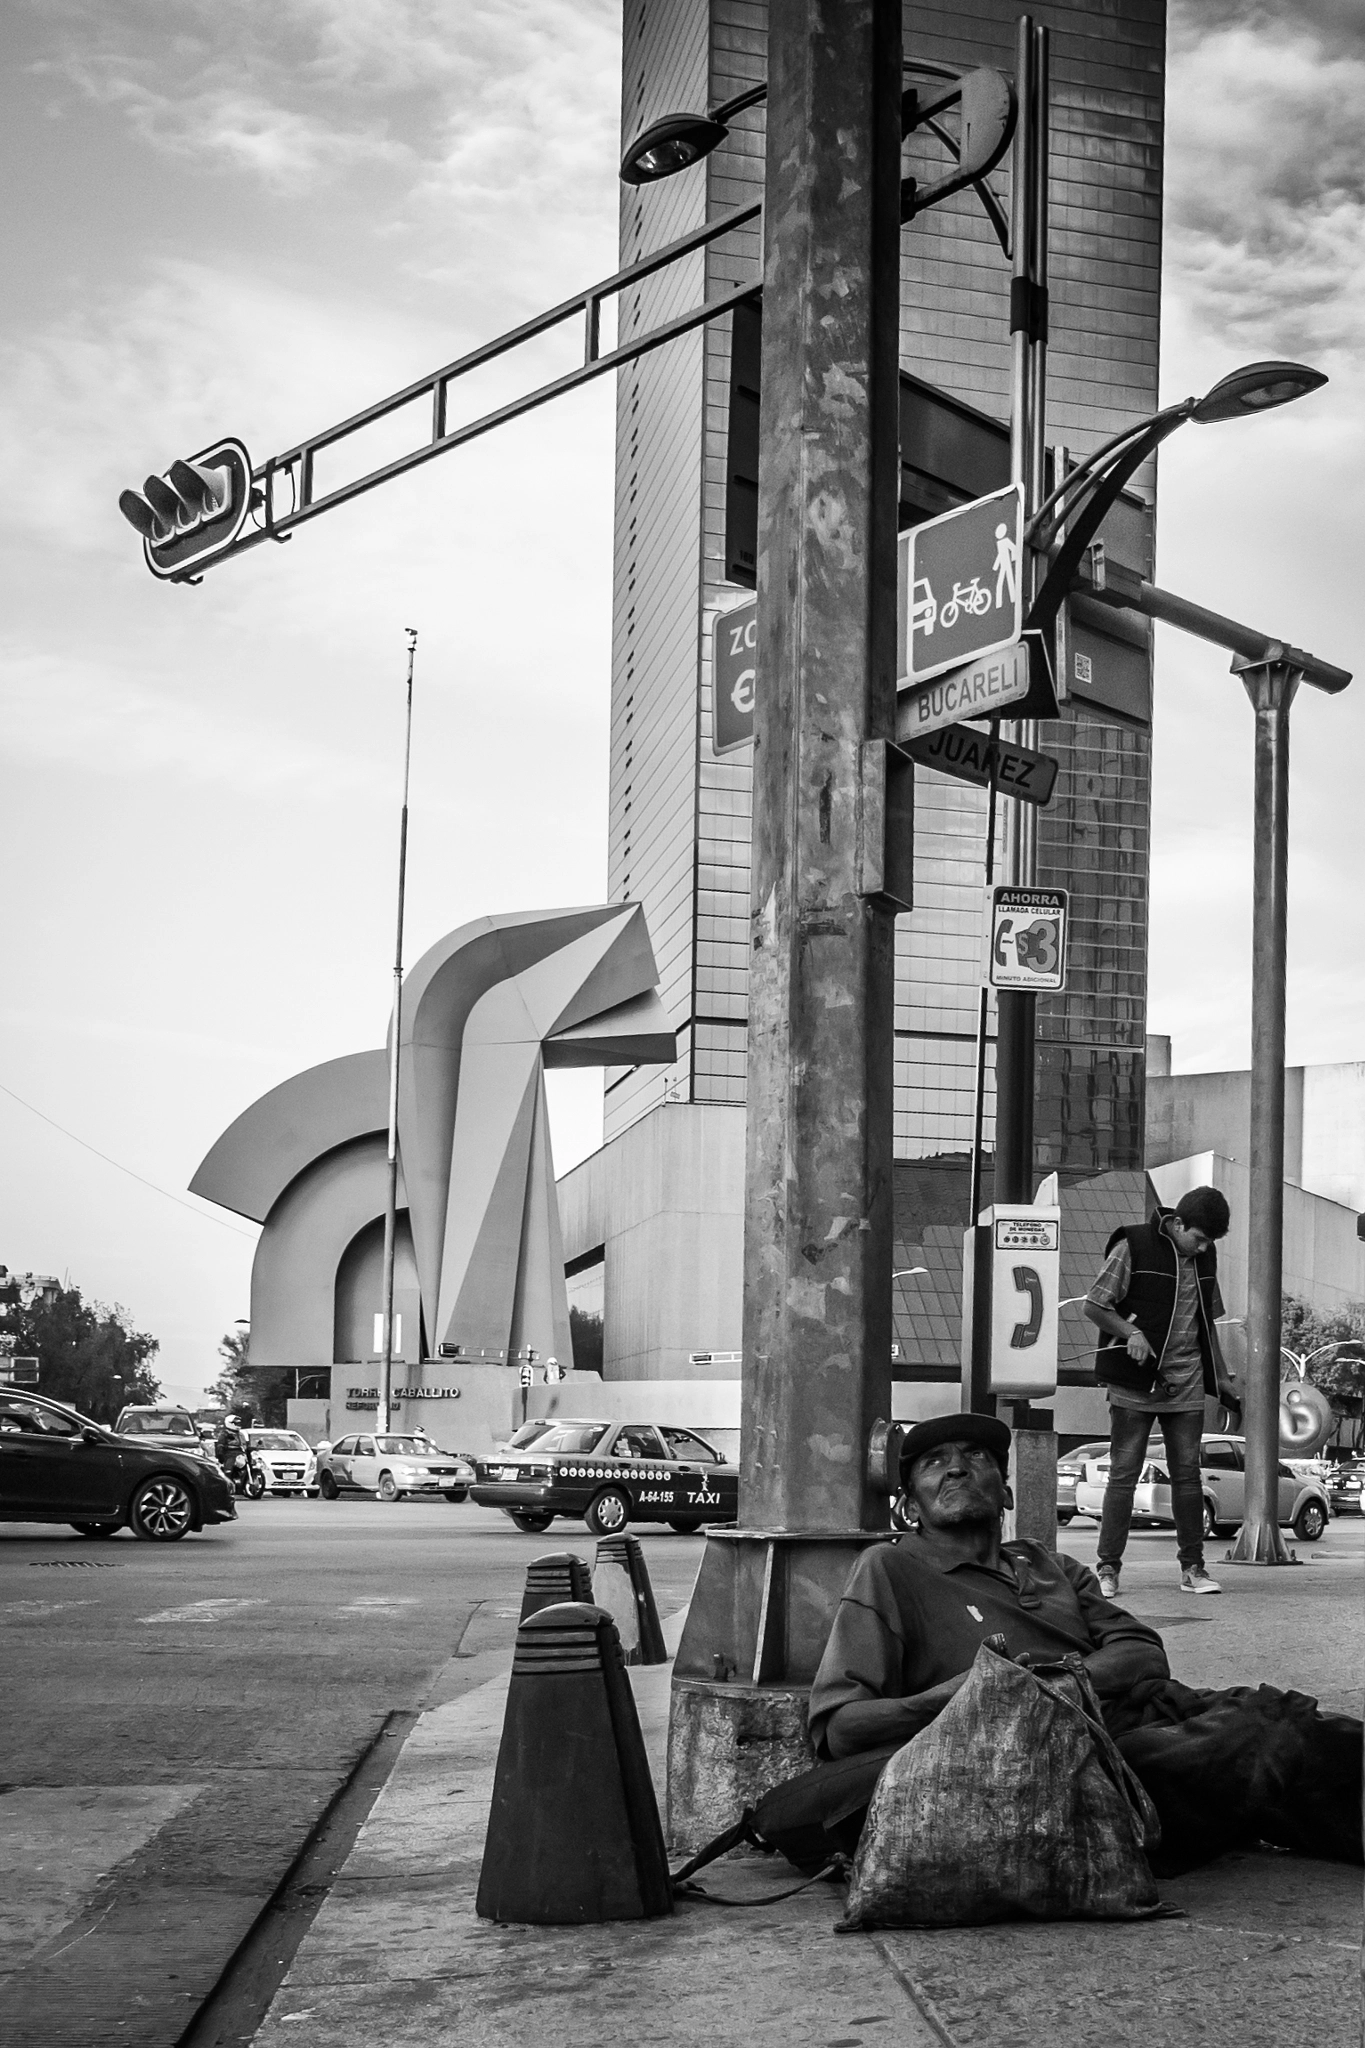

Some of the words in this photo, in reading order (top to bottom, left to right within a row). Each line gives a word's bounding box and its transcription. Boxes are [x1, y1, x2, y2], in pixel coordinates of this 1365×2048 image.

[918, 657, 1018, 722] BUCARELI
[1000, 892, 1060, 906] AHORRA
[998, 905, 1029, 914] LLAMADA
[1030, 907, 1061, 916] CELULAR
[391, 1387, 461, 1399] CABALLITO
[638, 1490, 675, 1503] A-64-155
[686, 1491, 720, 1504] TAXI
